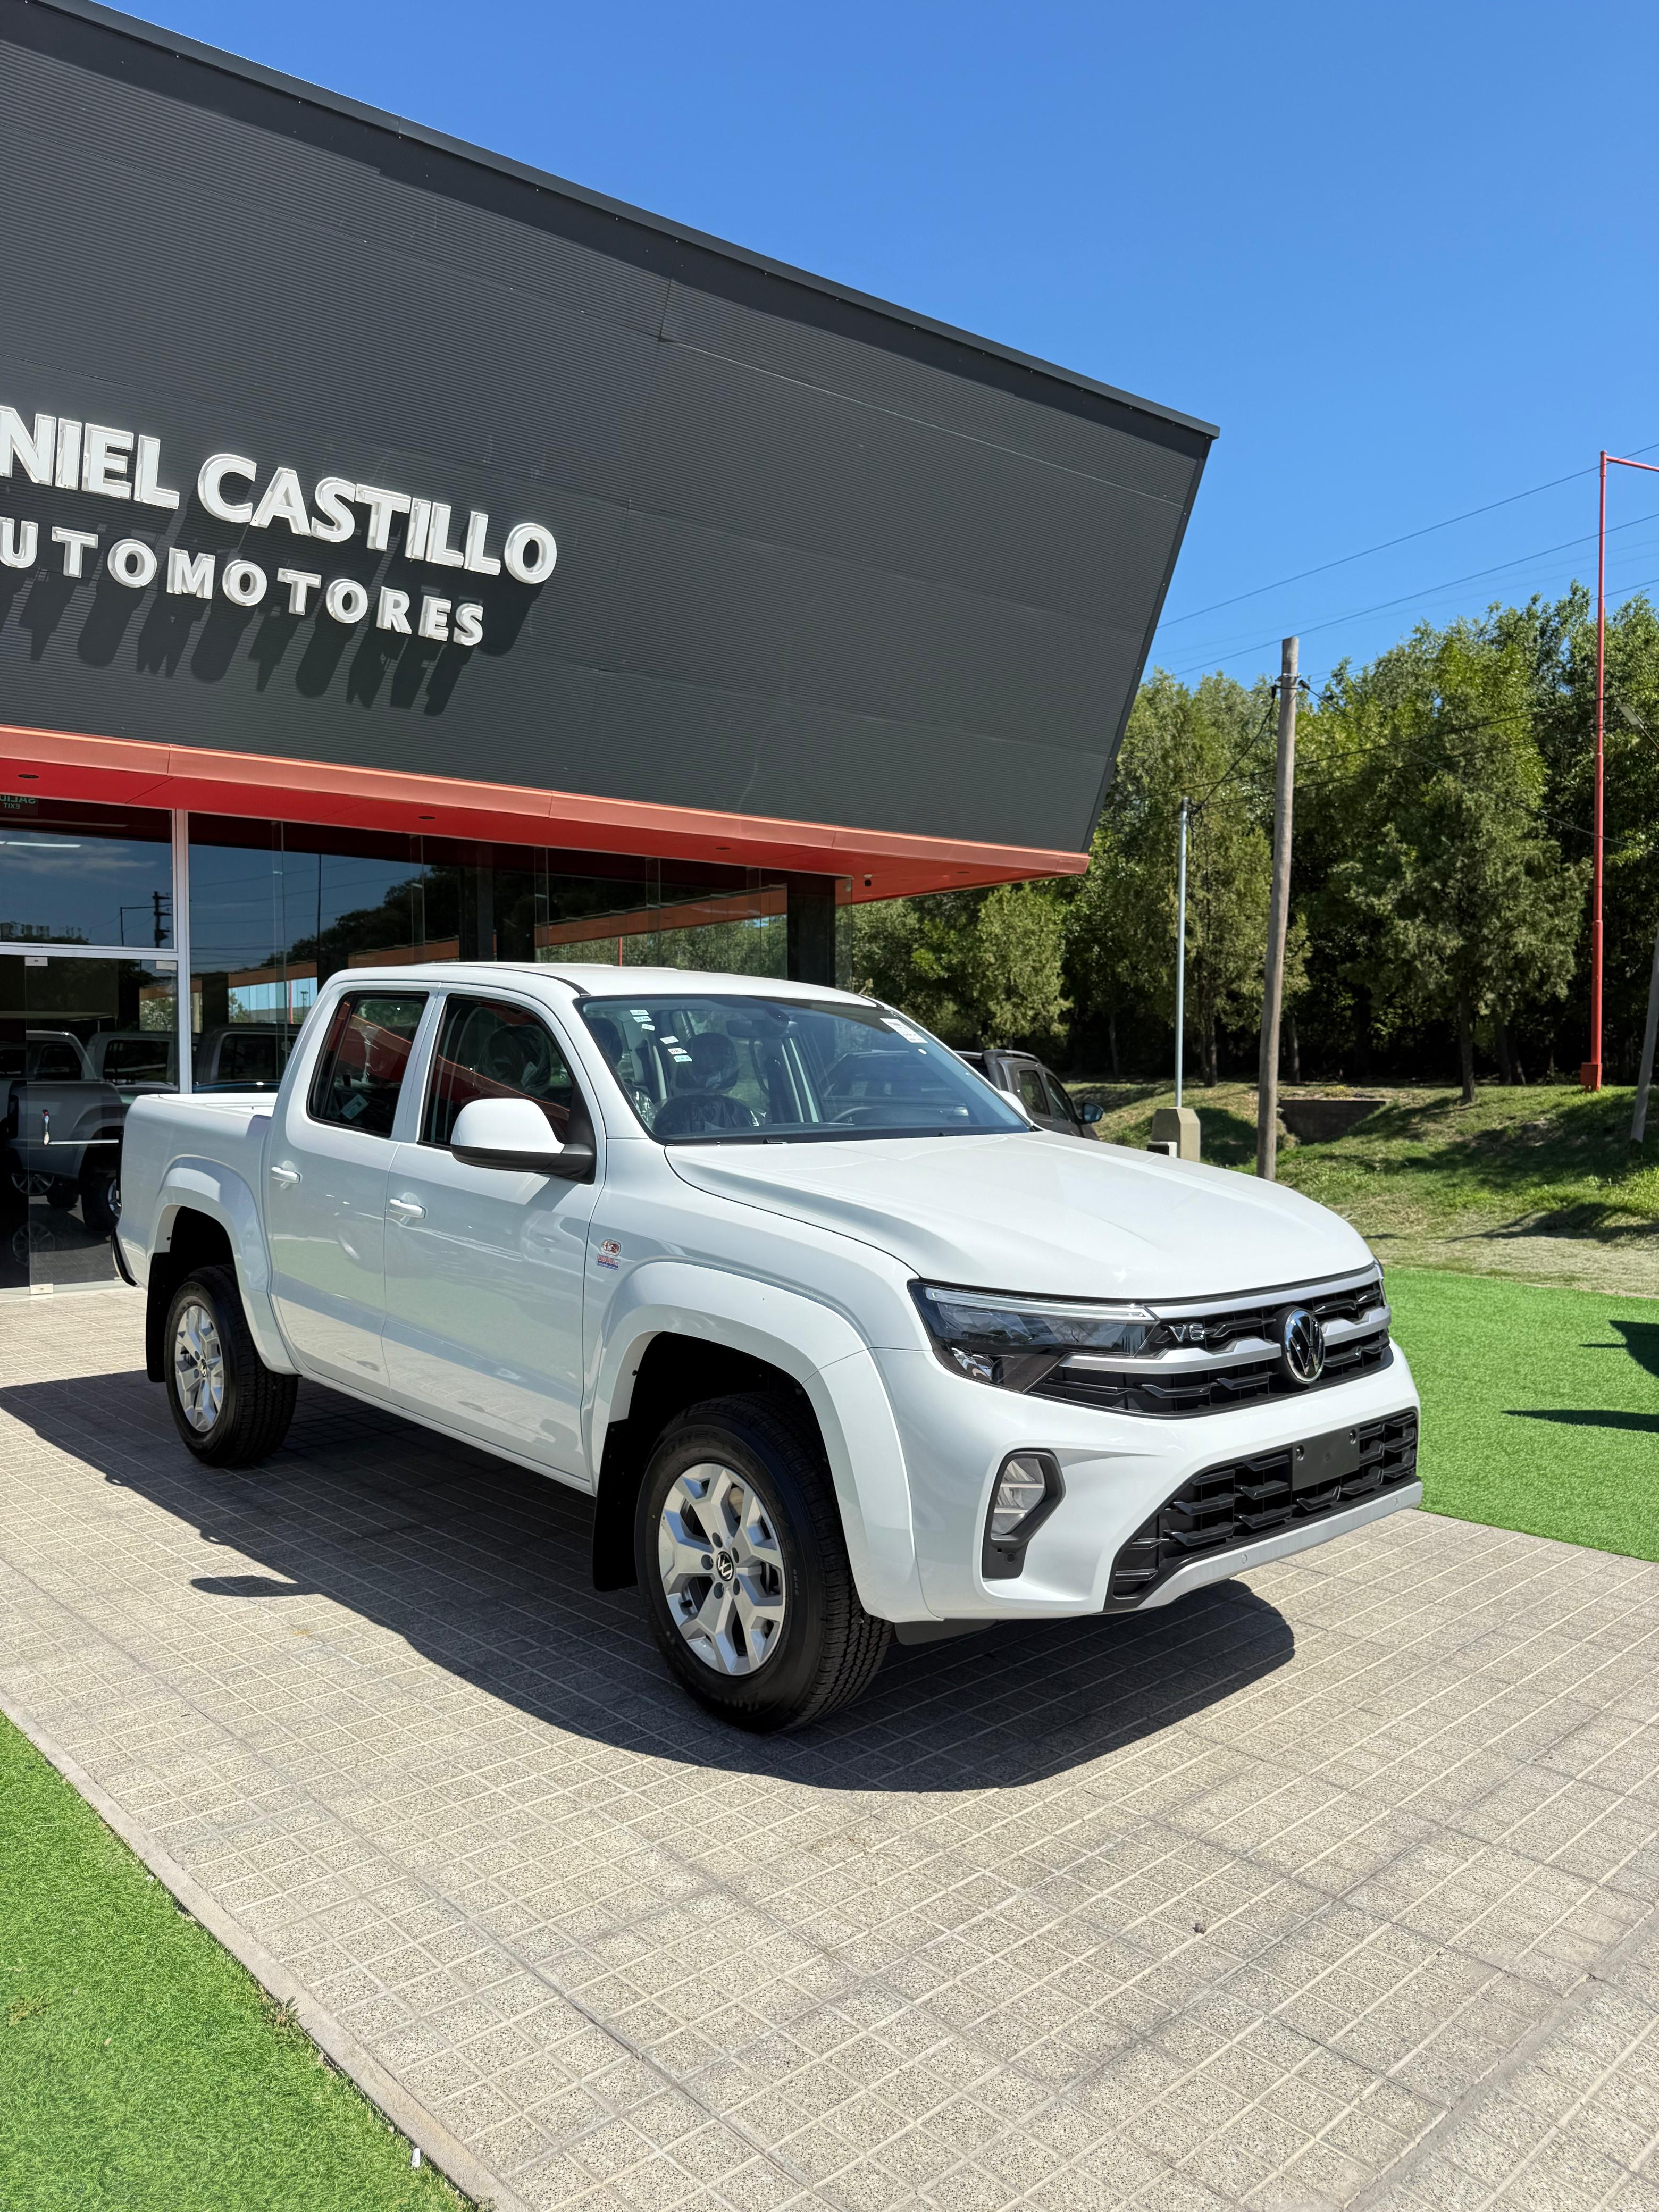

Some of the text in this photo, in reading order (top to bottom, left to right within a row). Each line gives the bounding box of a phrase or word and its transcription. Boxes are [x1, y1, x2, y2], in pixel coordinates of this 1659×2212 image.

[0, 406, 558, 584] NIEL CASTILLO
[0, 516, 484, 646] UTOMOTORES
[1169, 1323, 1205, 1342] V6
